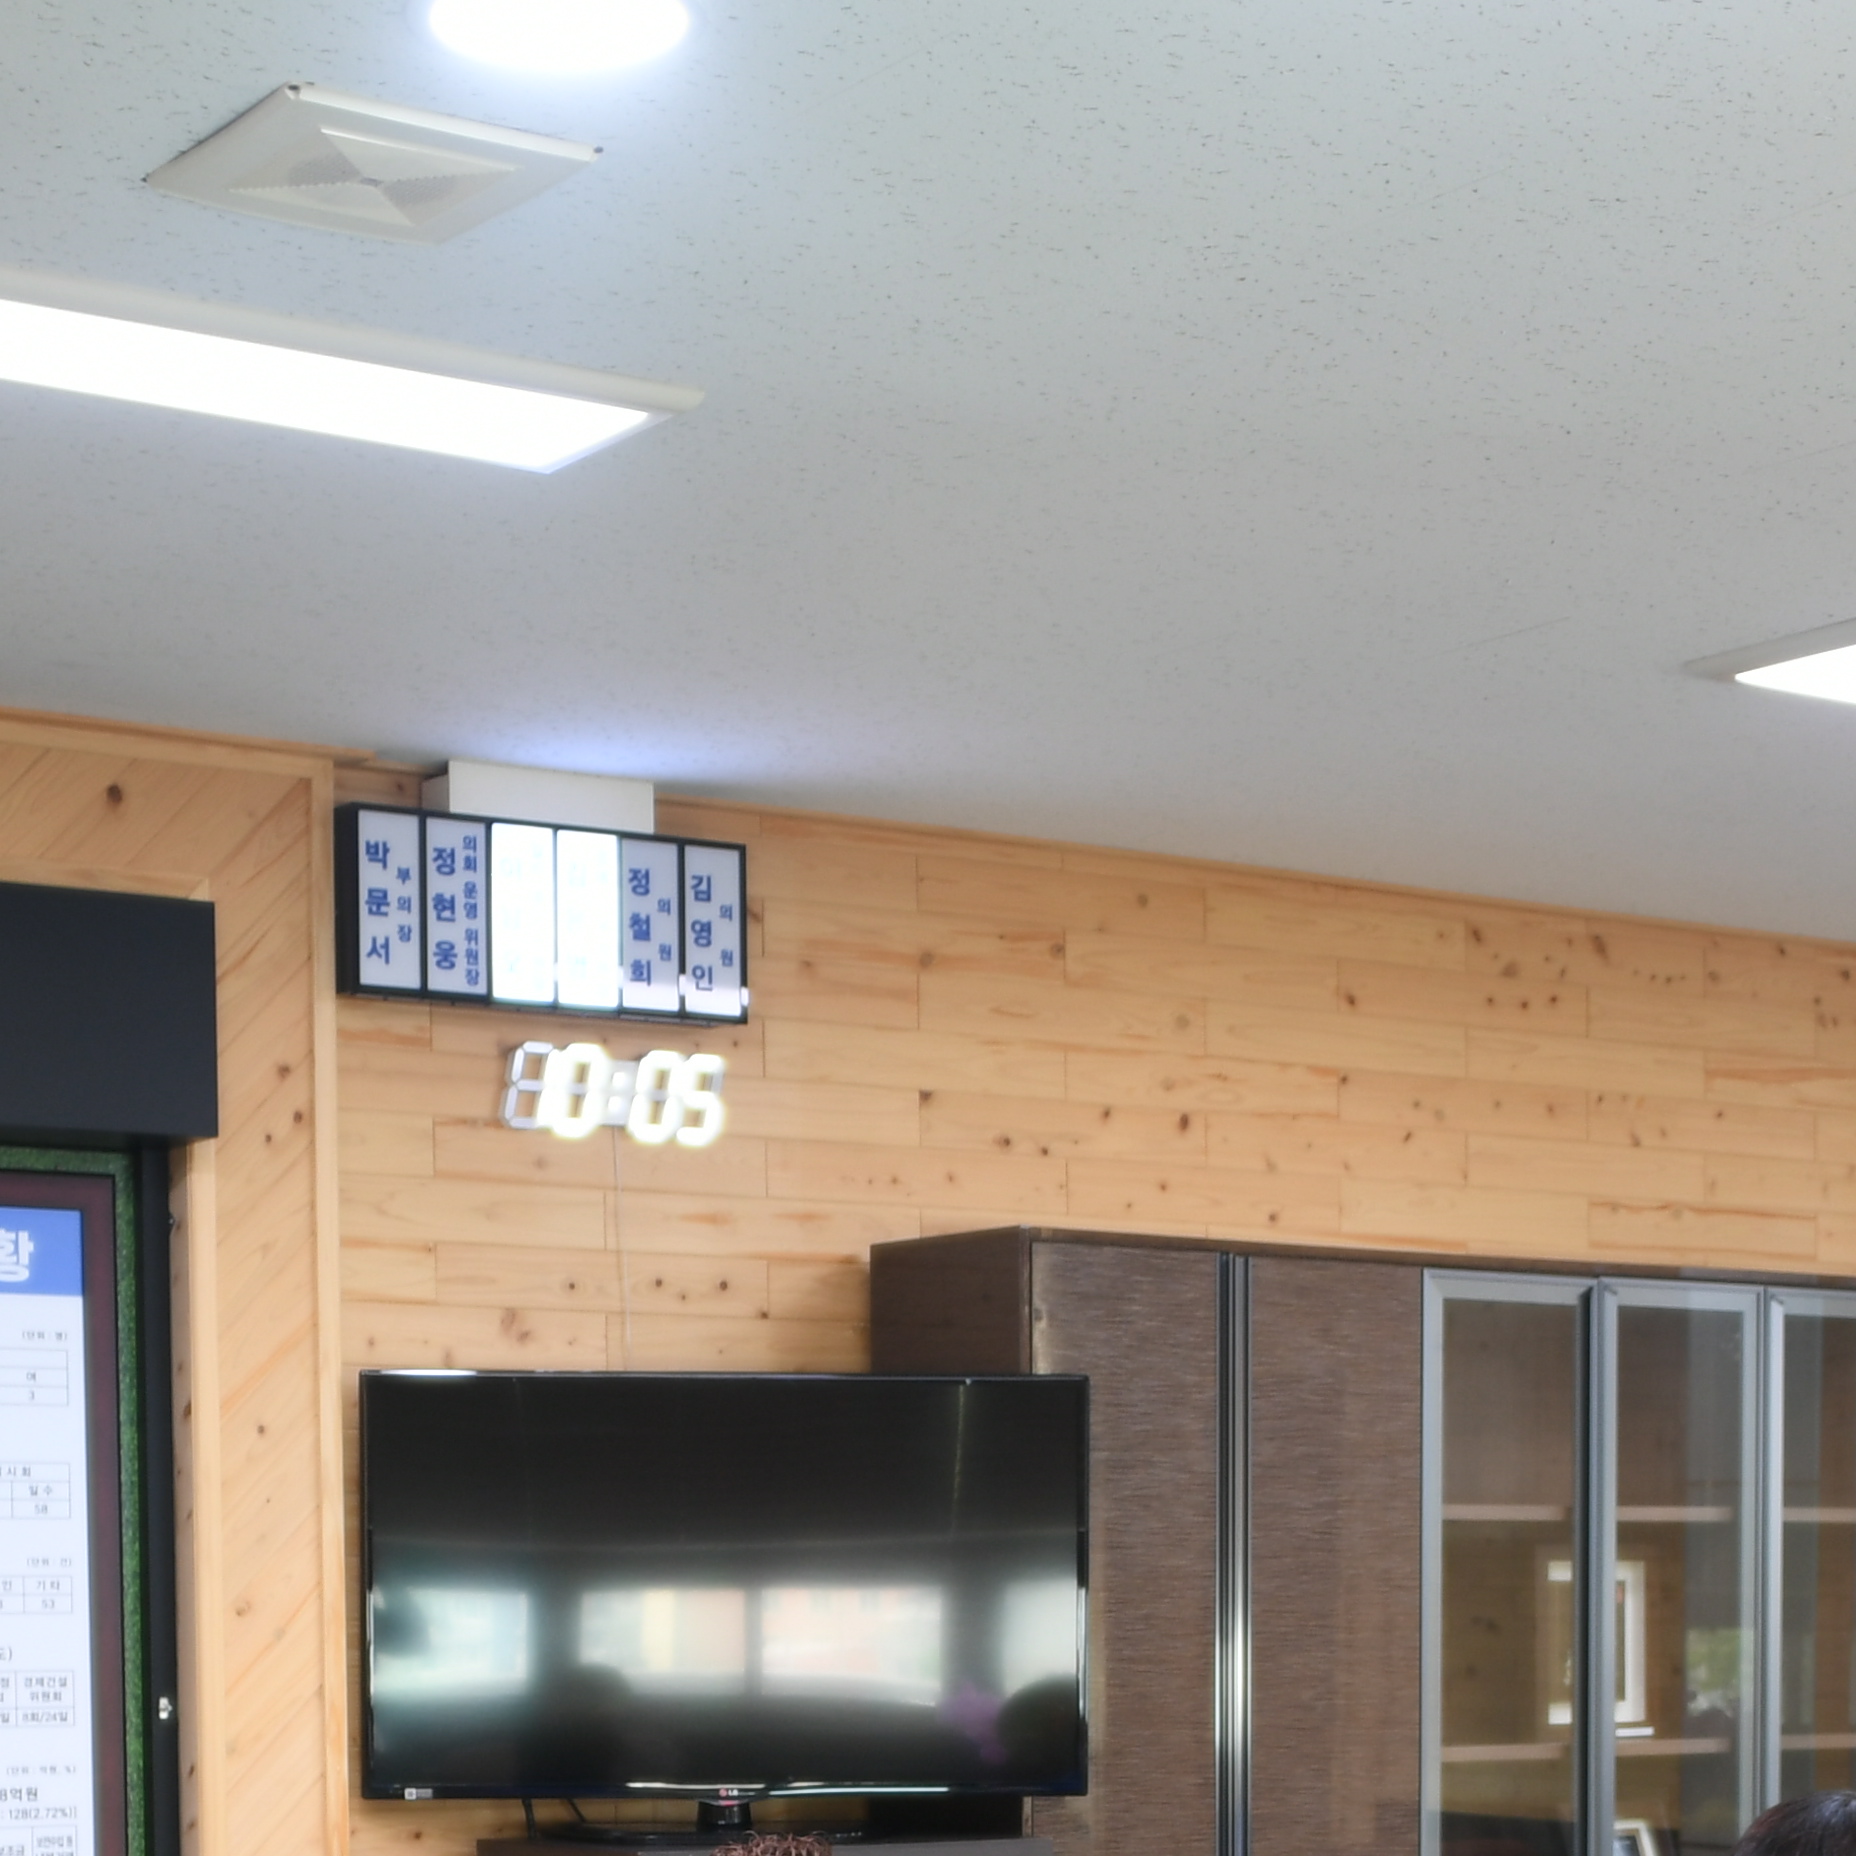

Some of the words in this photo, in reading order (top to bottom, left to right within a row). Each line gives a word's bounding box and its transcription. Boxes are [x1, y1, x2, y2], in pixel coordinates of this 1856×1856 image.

[364, 839, 391, 966] 박문서
[396, 867, 412, 943] 부의장
[432, 847, 458, 971] 정현웅
[689, 874, 714, 993] 김영인
[536, 1042, 726, 1148] 10:05
